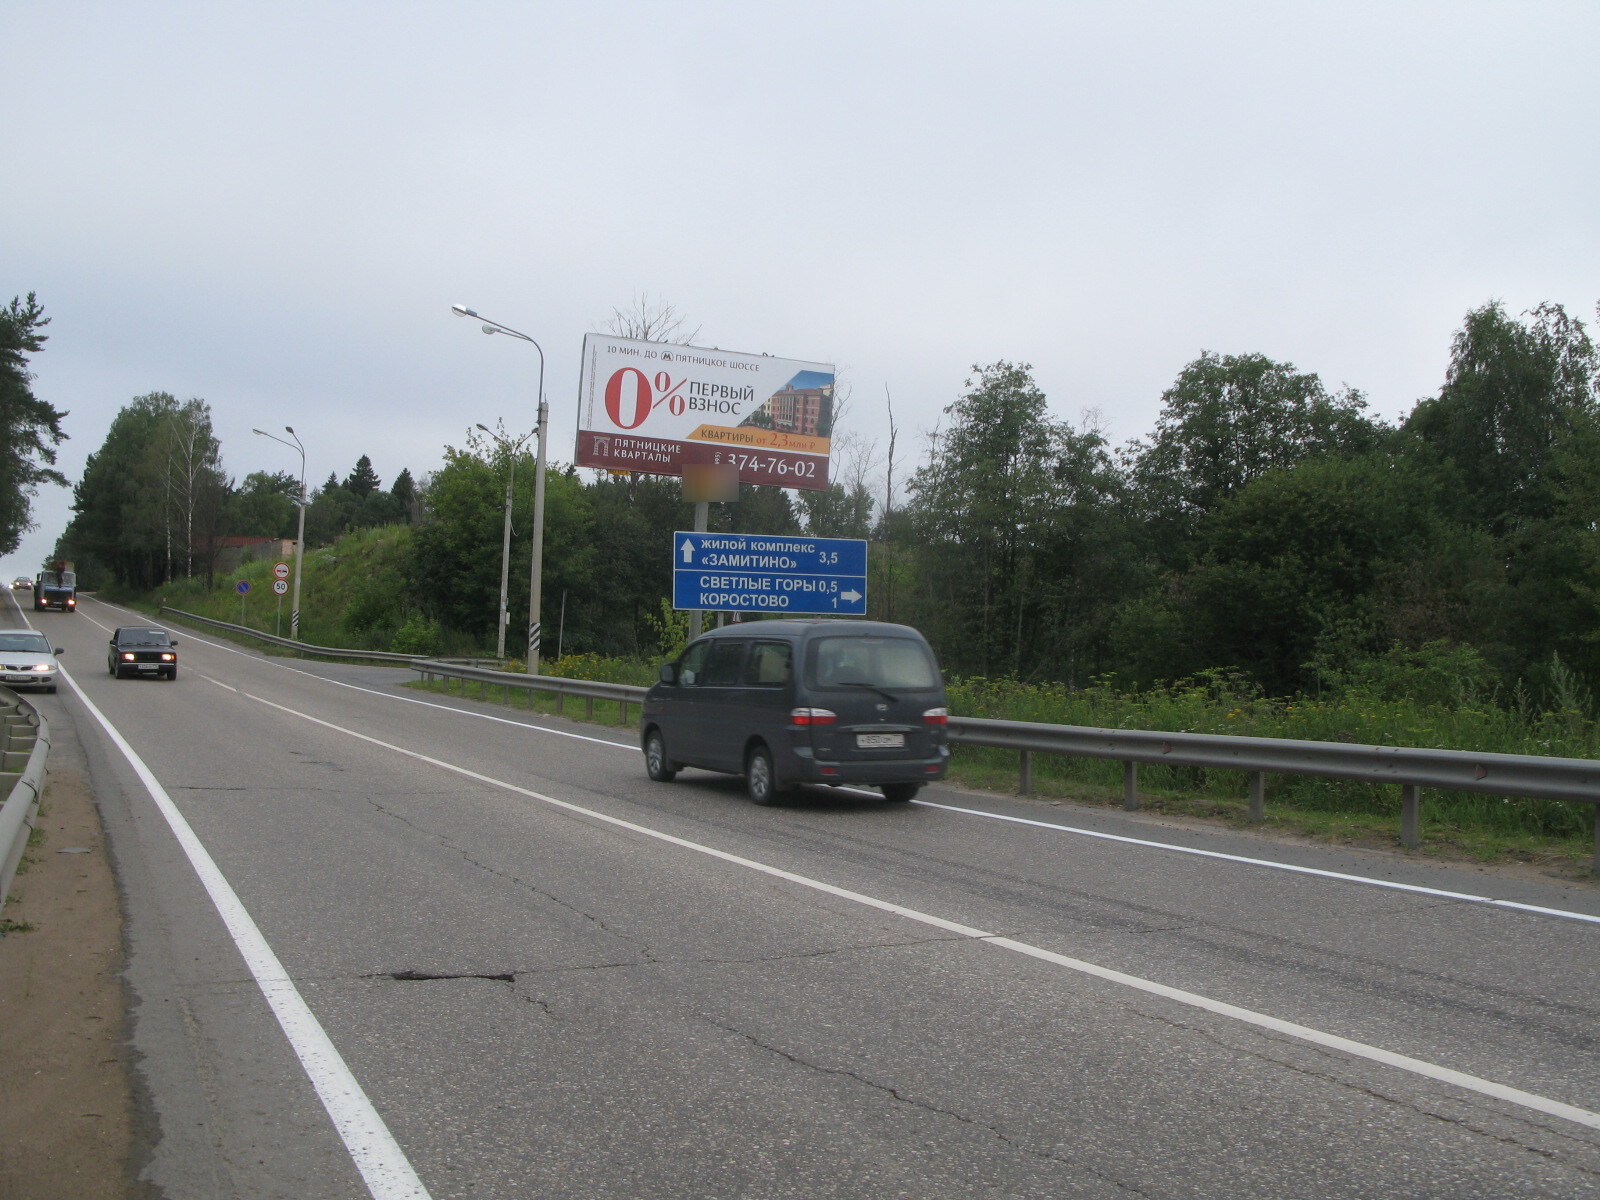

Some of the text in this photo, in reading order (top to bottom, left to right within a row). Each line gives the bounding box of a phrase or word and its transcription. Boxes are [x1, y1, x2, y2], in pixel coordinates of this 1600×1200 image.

[607, 345, 617, 354] 10
[619, 347, 642, 357] МИН.
[644, 350, 657, 359] ДО
[675, 354, 727, 368] ПЯТНИЦКОЕ
[729, 361, 760, 372] ШОССЕ
[604, 366, 686, 430] 0%
[689, 381, 754, 402] ПЕРВЫЙ
[689, 396, 741, 415] ВЗНОС
[614, 438, 681, 454] ПЯТНИЦКИЕ
[701, 429, 754, 443] КВАРТИРЫ
[769, 432, 788, 448] 2,3
[788, 441, 807, 449] млн
[614, 449, 671, 463] КВАРТАЛЫ
[701, 552, 838, 569] «ЗАМИТИНО» 3,5
[276, 582, 286, 590] 50
[700, 575, 838, 594] СВЕТЛЫЕ ГОРЫ 0,5
[700, 592, 838, 609] КОРОСТОВО 1
